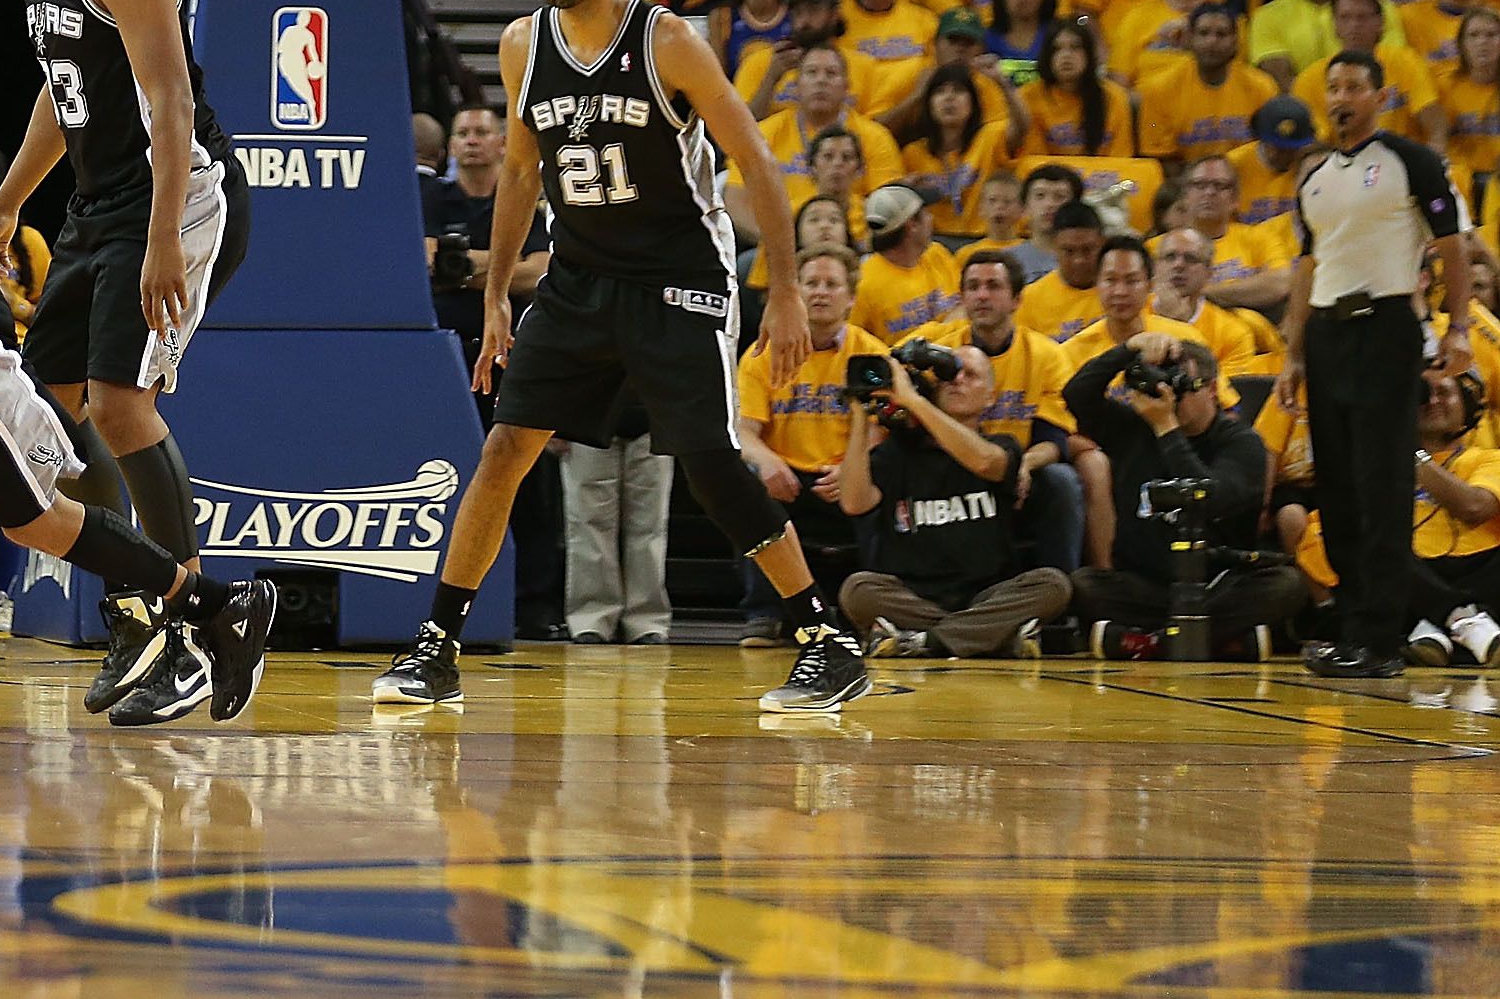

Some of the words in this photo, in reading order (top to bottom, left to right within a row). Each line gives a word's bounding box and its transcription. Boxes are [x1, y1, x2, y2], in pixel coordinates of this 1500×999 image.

[26, 2, 84, 55] PURS
[278, 103, 309, 120] NBA
[530, 94, 650, 141] SPURS
[234, 147, 311, 188] NBA
[314, 149, 366, 189] TV
[556, 143, 640, 206] 21
[192, 498, 447, 548] PLAYOFFS
[914, 496, 968, 526] NBA
